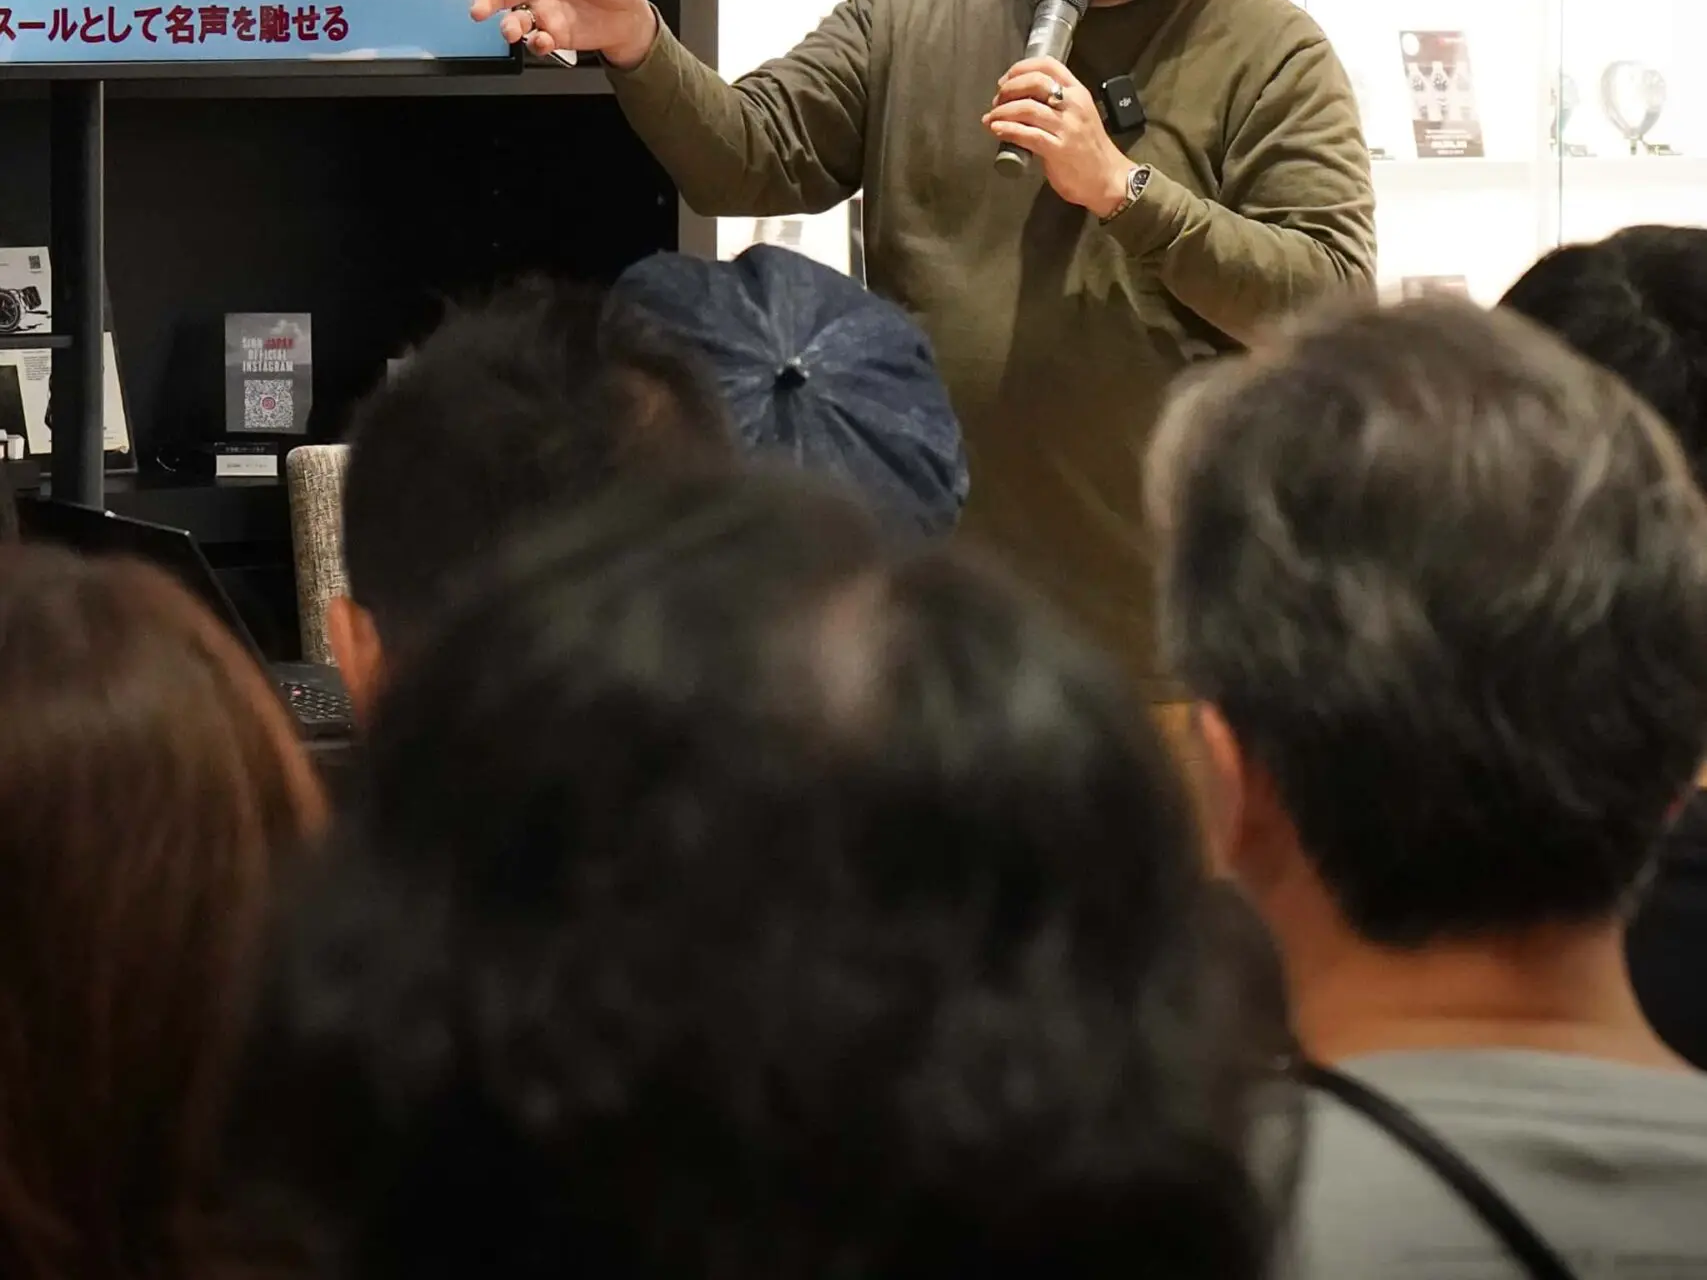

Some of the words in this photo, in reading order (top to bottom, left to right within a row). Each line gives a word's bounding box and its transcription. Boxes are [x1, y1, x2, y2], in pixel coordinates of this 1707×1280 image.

[0, 4, 349, 44] スールとして名声を馳せる
[247, 348, 287, 361] OFFICIAL
[242, 360, 294, 373] INSTAGRAM
